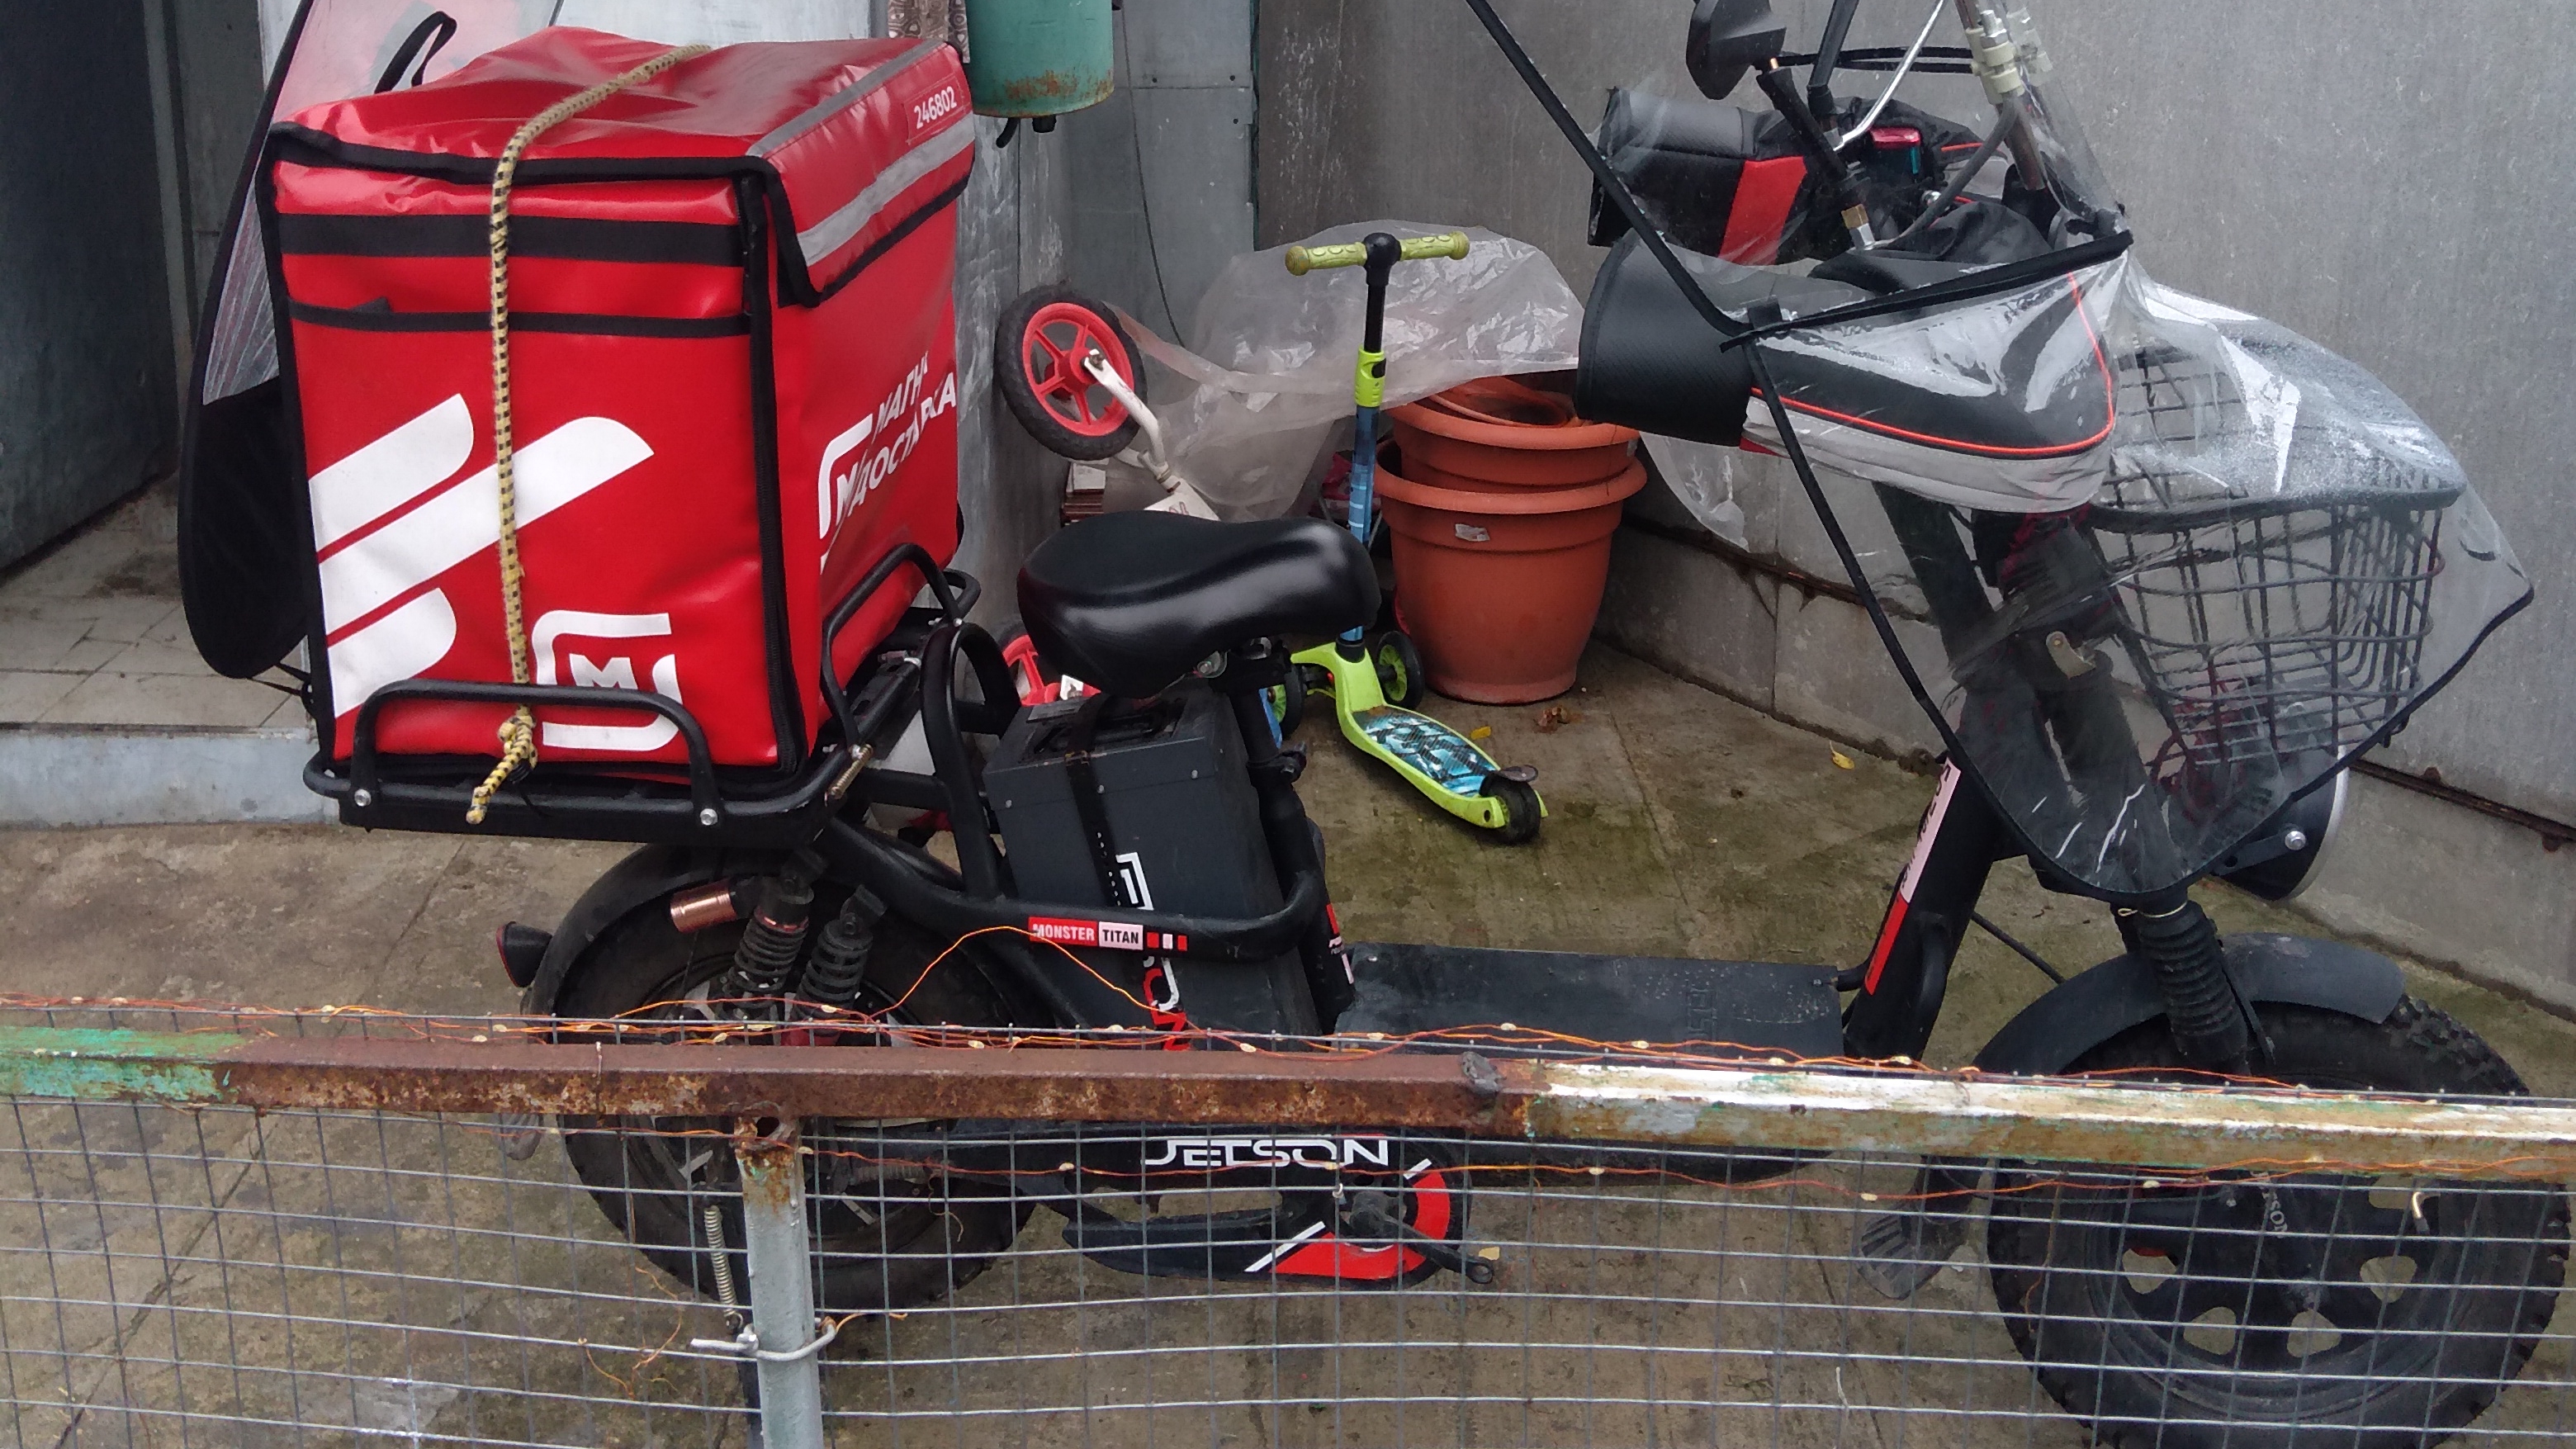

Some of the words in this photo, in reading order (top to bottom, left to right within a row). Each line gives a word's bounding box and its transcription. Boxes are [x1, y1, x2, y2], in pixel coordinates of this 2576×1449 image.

[914, 86, 957, 130] 246802
[1032, 923, 1096, 941] MONSTER
[1101, 929, 1139, 945] TITAN
[1144, 1137, 1389, 1167] JETSON
